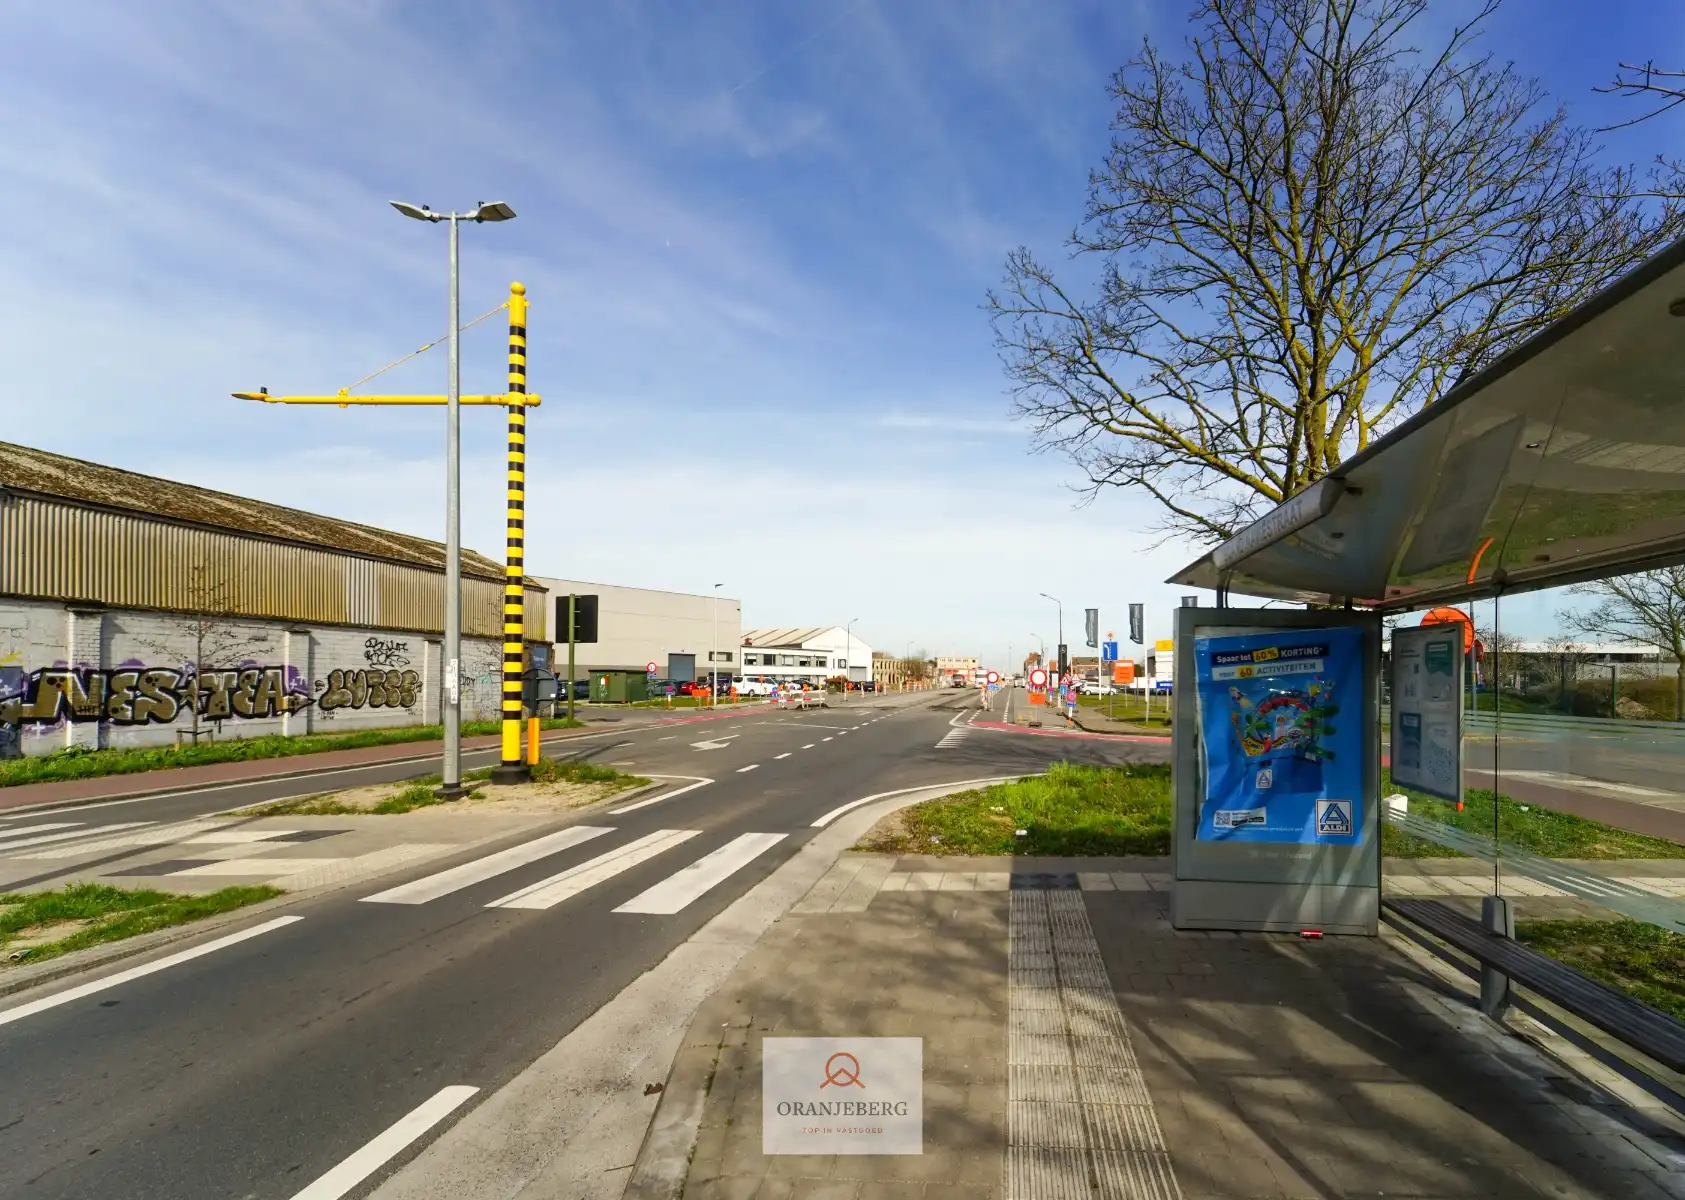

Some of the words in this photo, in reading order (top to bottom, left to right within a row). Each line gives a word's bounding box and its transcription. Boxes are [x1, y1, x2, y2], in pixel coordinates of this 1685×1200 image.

[1216, 655, 1240, 664] Spaar
[1255, 649, 1278, 661] 60%
[1240, 667, 1253, 678] 60
[1256, 662, 1316, 675] ACTIVITEITEN
[1322, 823, 1348, 831] ALDI
